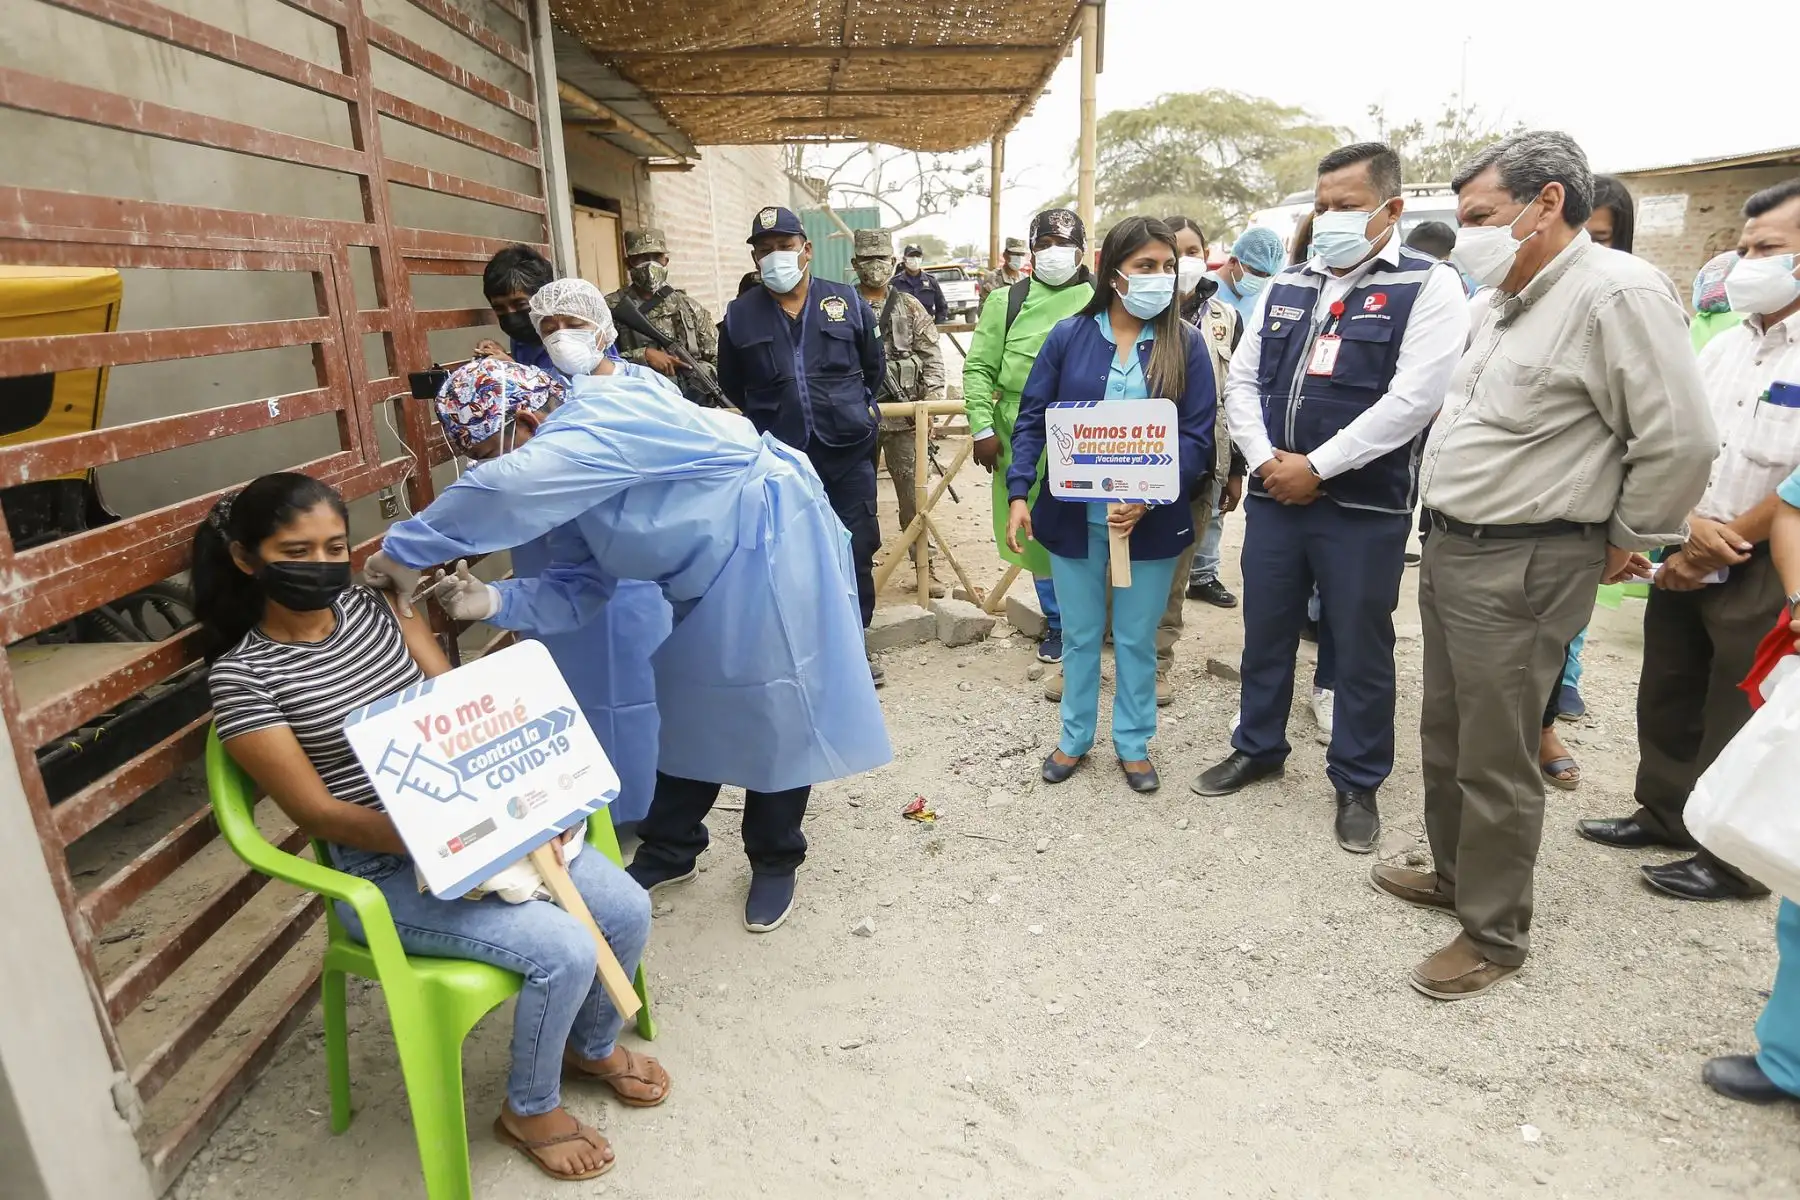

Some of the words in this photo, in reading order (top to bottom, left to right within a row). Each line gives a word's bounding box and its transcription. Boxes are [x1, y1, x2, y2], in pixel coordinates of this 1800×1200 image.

[1073, 424, 1127, 439] Vamos
[1132, 426, 1142, 438] a
[1146, 424, 1166, 438] tu
[1077, 440, 1164, 453] encuentro
[1131, 456, 1143, 464] ya!
[413, 714, 451, 743] Yo
[455, 694, 497, 726] me
[438, 697, 529, 759] vacuné
[467, 736, 523, 773] contra
[521, 727, 541, 746] la
[485, 735, 571, 790] COVID-19
